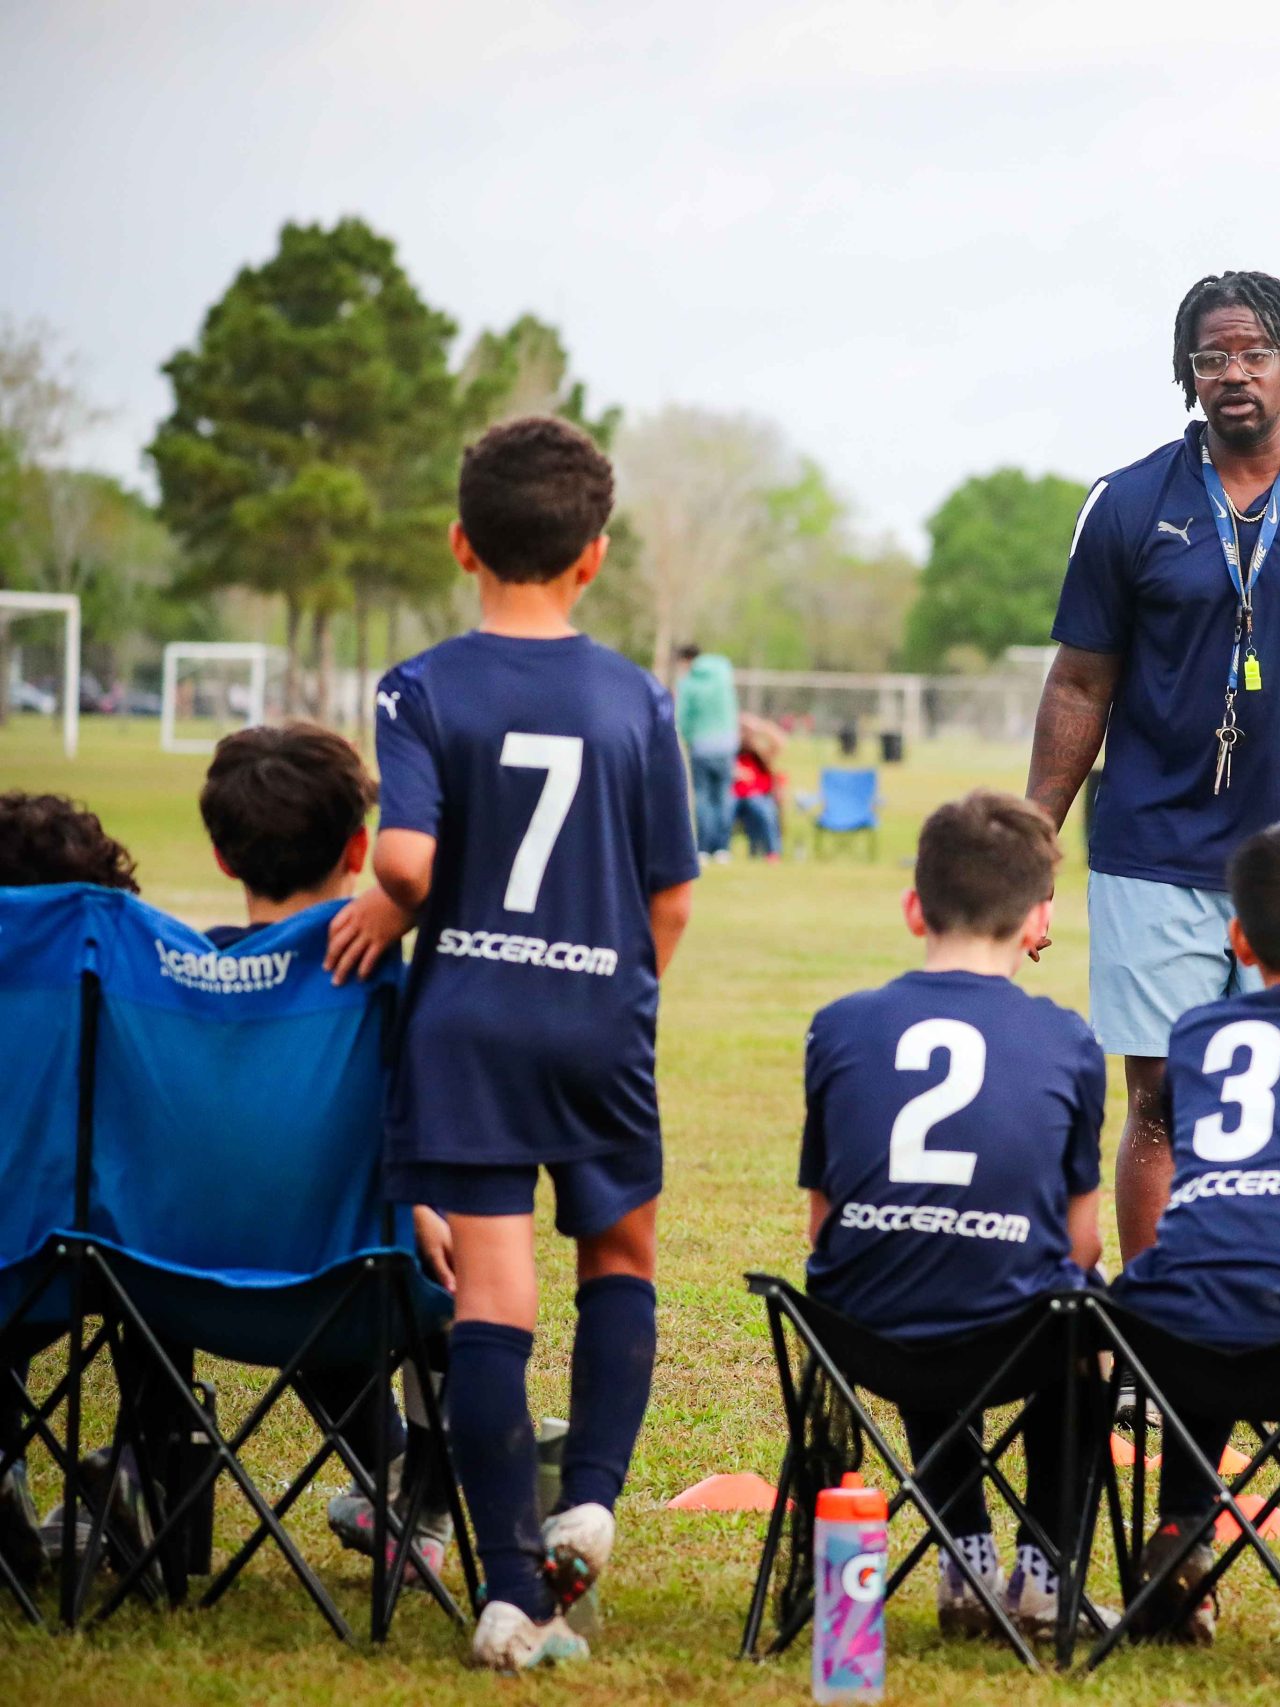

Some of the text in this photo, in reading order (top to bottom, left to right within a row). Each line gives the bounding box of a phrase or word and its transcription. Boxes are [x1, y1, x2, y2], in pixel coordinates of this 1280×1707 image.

[500, 731, 584, 914] 7
[888, 1017, 987, 1186] 2
[840, 1202, 1031, 1243] SOCCER.COM
[841, 1552, 885, 1603] G
